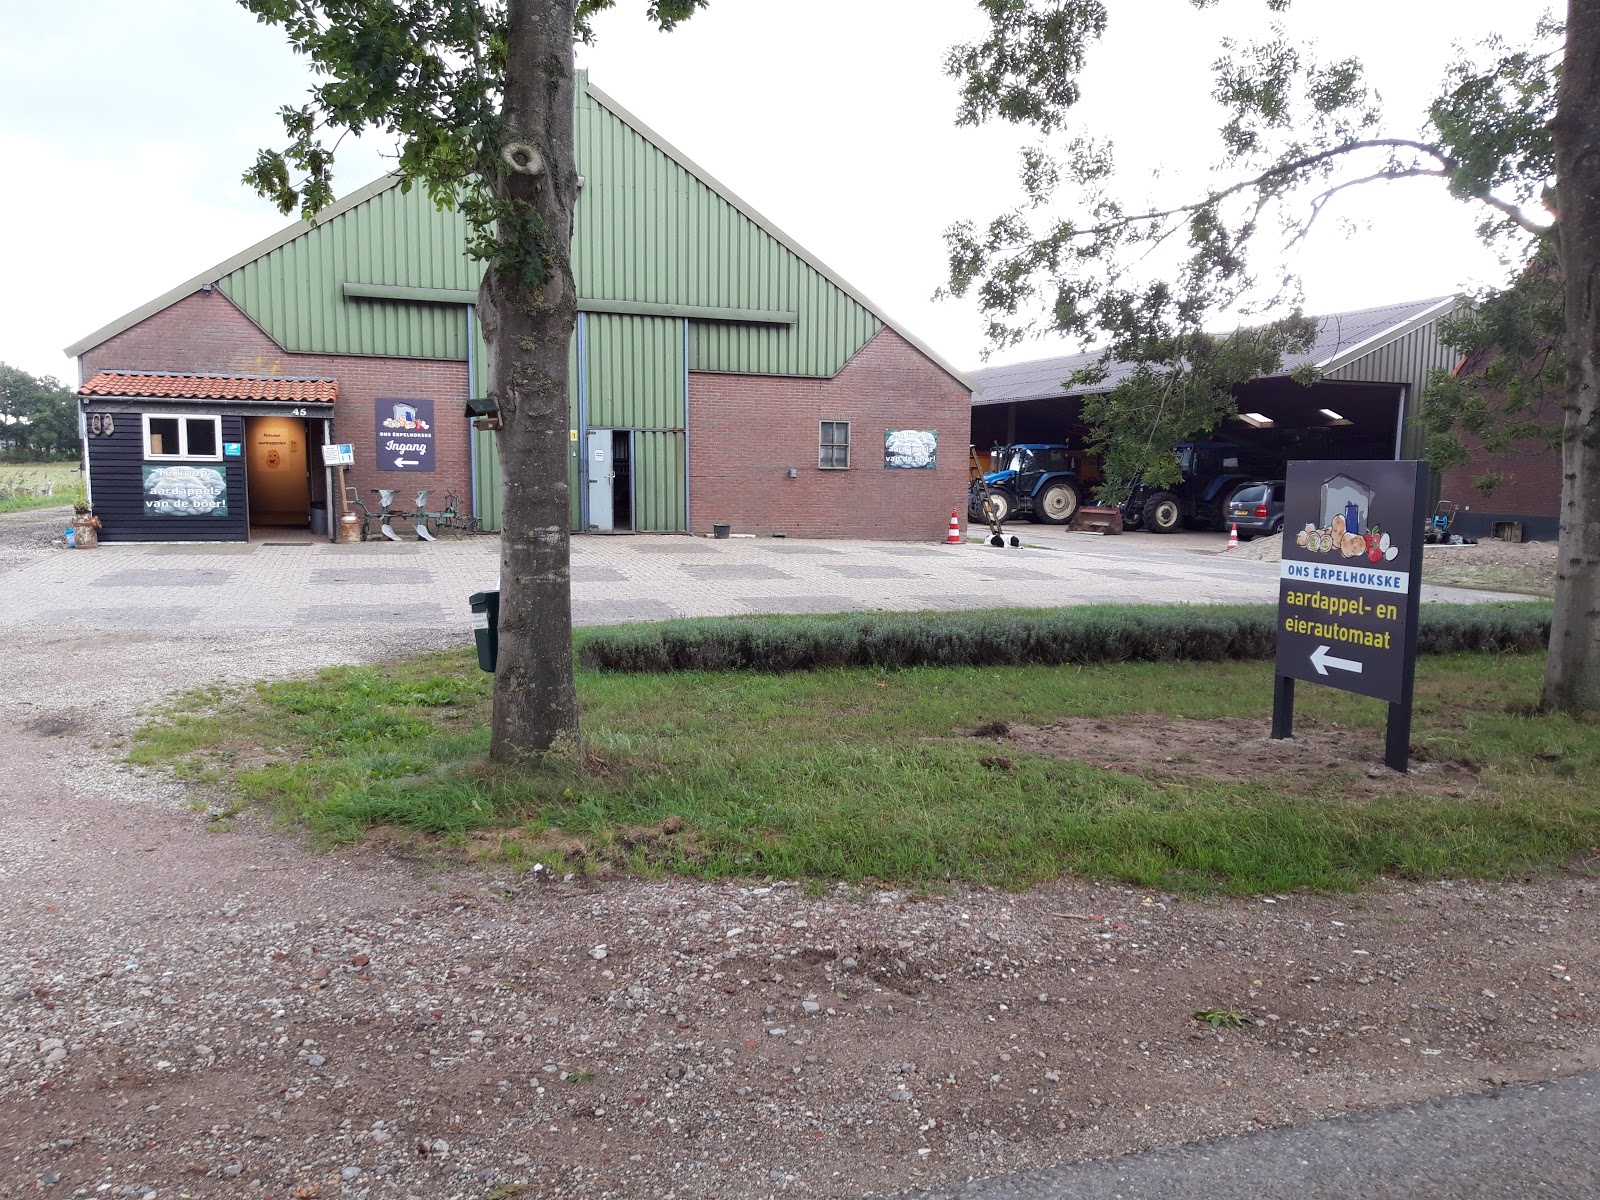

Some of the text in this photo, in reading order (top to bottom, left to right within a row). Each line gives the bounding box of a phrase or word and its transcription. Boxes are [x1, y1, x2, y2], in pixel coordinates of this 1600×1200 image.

[292, 408, 307, 416] 45
[385, 439, 427, 455] Ingang
[158, 468, 173, 476] Te
[149, 486, 221, 497] aardappels
[145, 499, 226, 508] van de boer!
[1287, 564, 1401, 589] ONS ÈRPELHOKSKE
[1286, 590, 1397, 621] aardappel- en
[1285, 615, 1391, 650] eierautomaat
